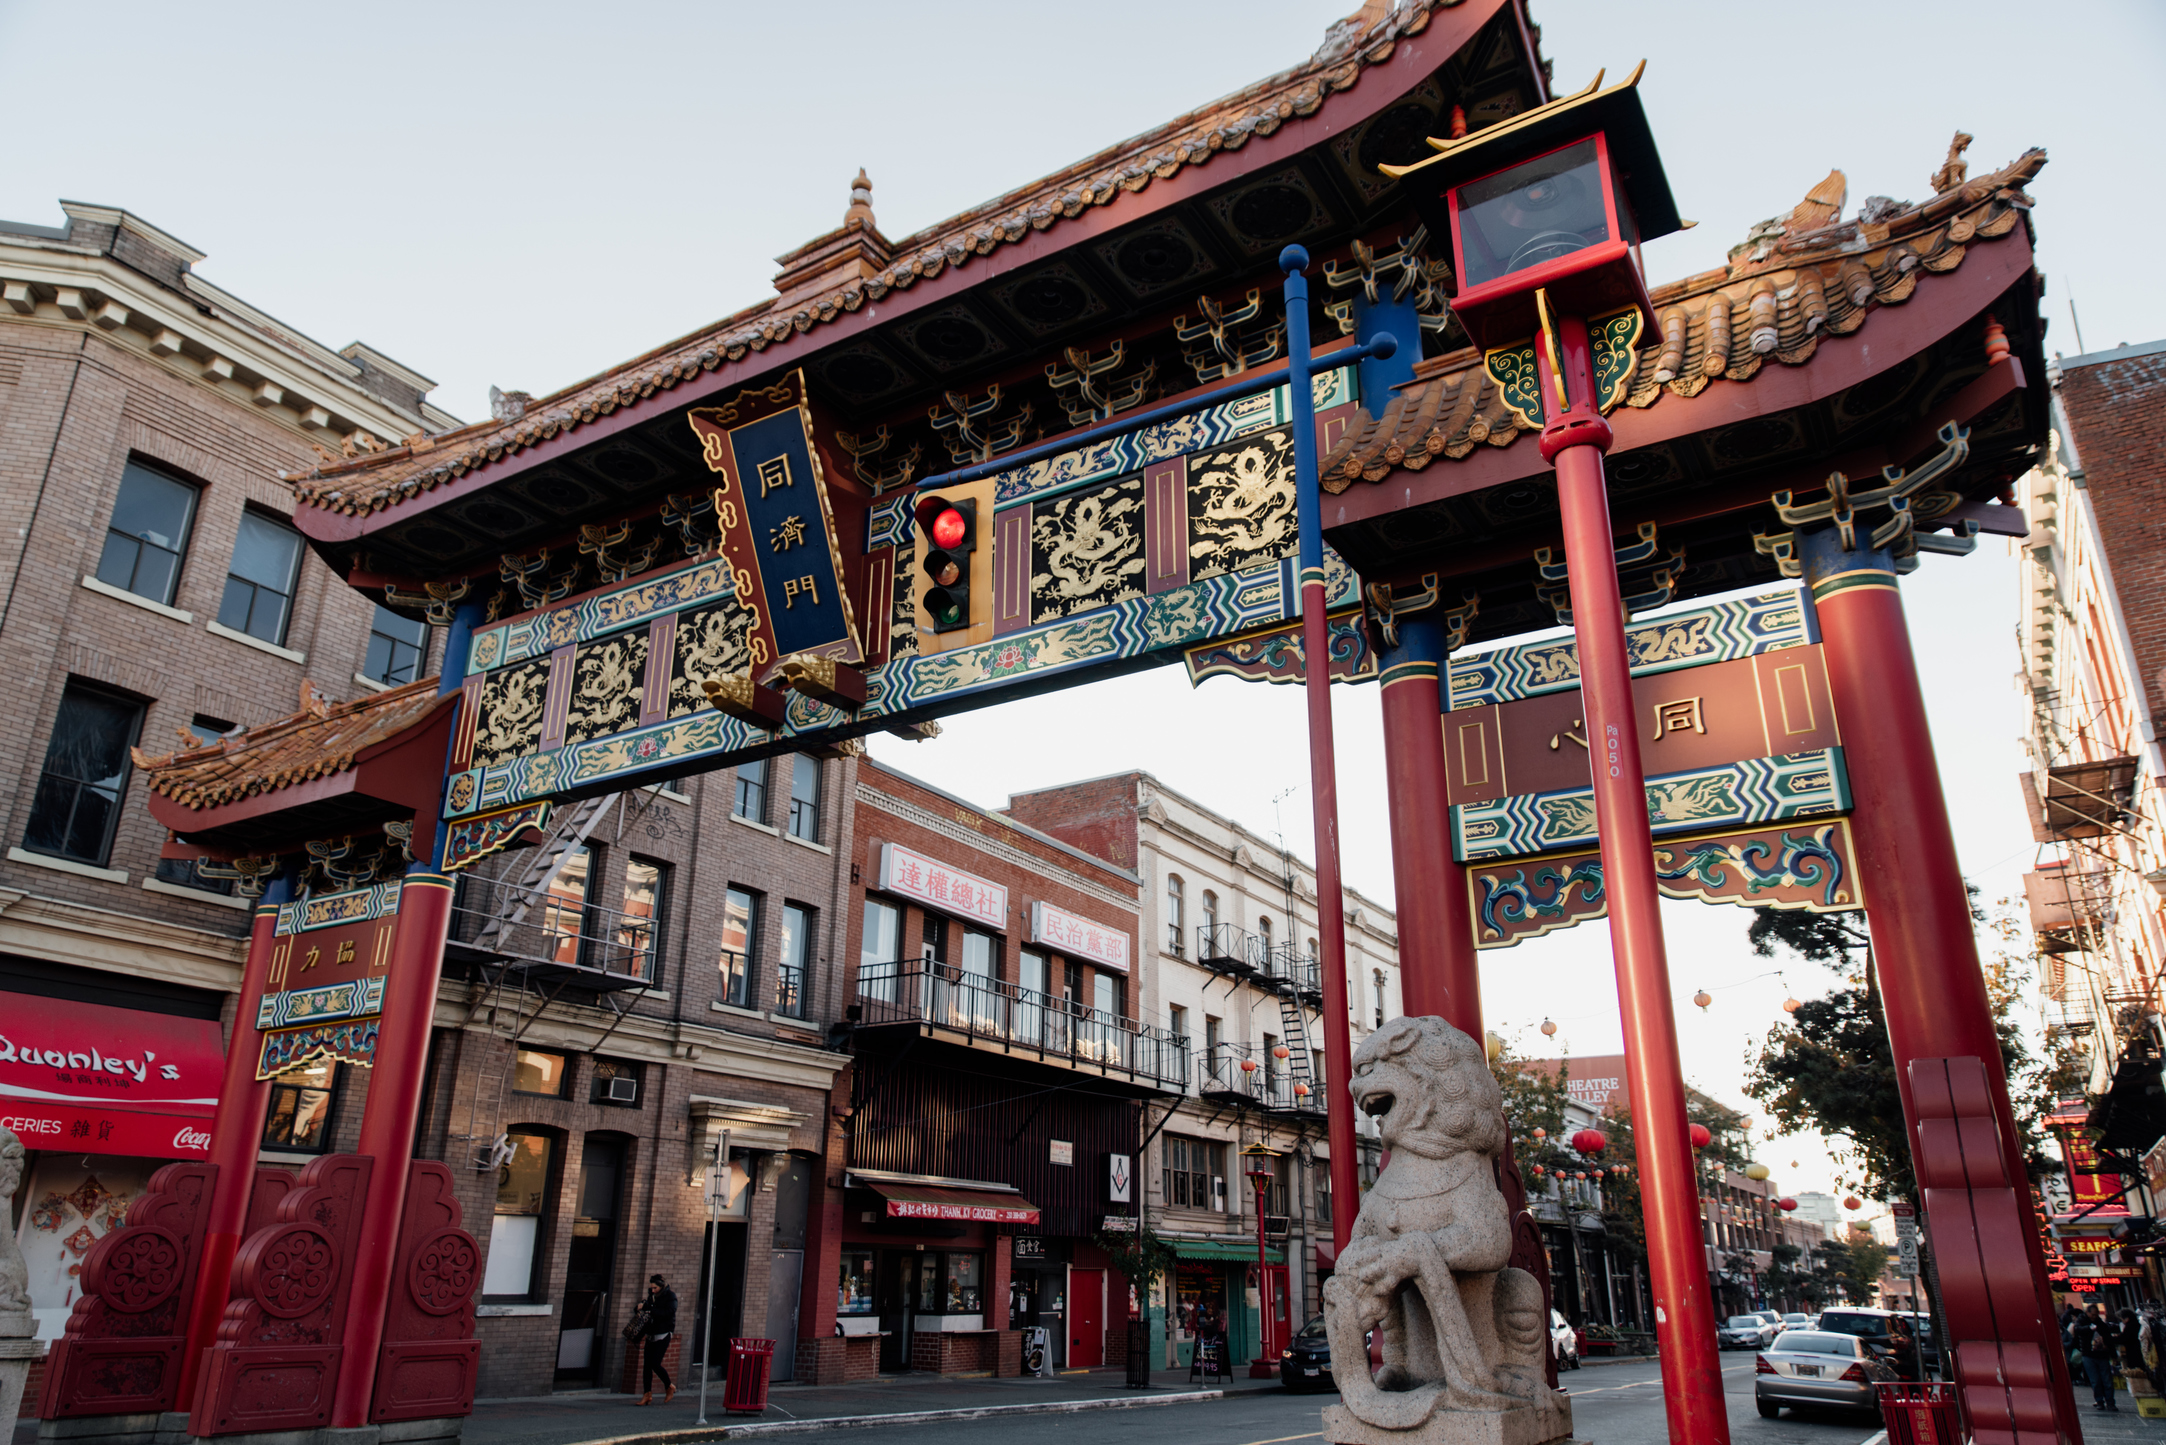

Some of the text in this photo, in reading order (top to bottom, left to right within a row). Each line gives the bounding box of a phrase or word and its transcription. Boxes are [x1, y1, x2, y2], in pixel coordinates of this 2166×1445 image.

[755, 452, 820, 610] 同濟門
[897, 857, 999, 920] 達權總社
[1045, 914, 1123, 962] 民治黨部
[0, 1034, 181, 1083] Quanley's
[1566, 1077, 1620, 1092] HEATRE
[940, 1205, 960, 1218] THANH
[962, 1208, 971, 1219] KY
[972, 1208, 997, 1220] GROCERY
[2071, 1284, 2096, 1292] OPEN
